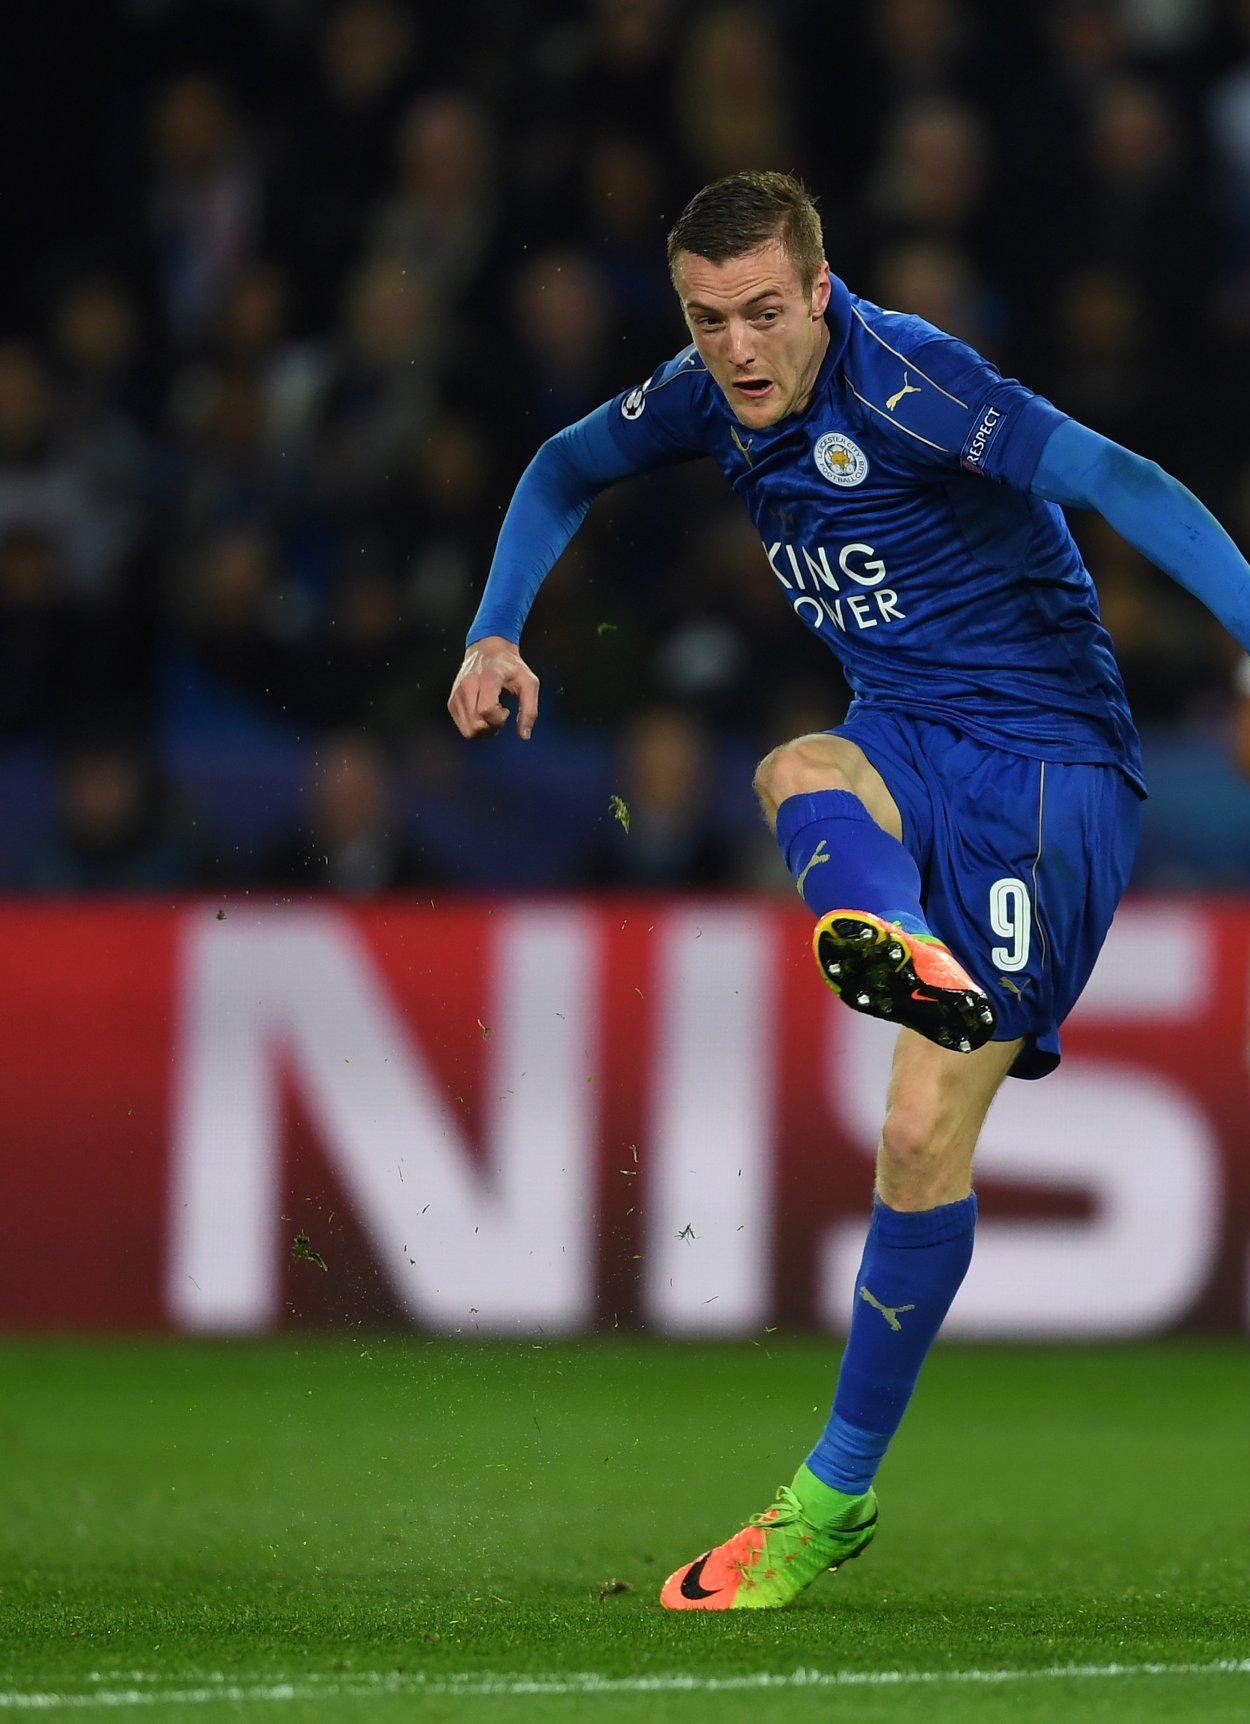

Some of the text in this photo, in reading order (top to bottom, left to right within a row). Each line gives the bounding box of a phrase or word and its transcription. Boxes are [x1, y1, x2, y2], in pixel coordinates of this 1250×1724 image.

[846, 442, 862, 457] CITY
[966, 407, 1000, 466] RESPECT
[762, 540, 887, 592] KING
[989, 877, 1031, 972] 9
